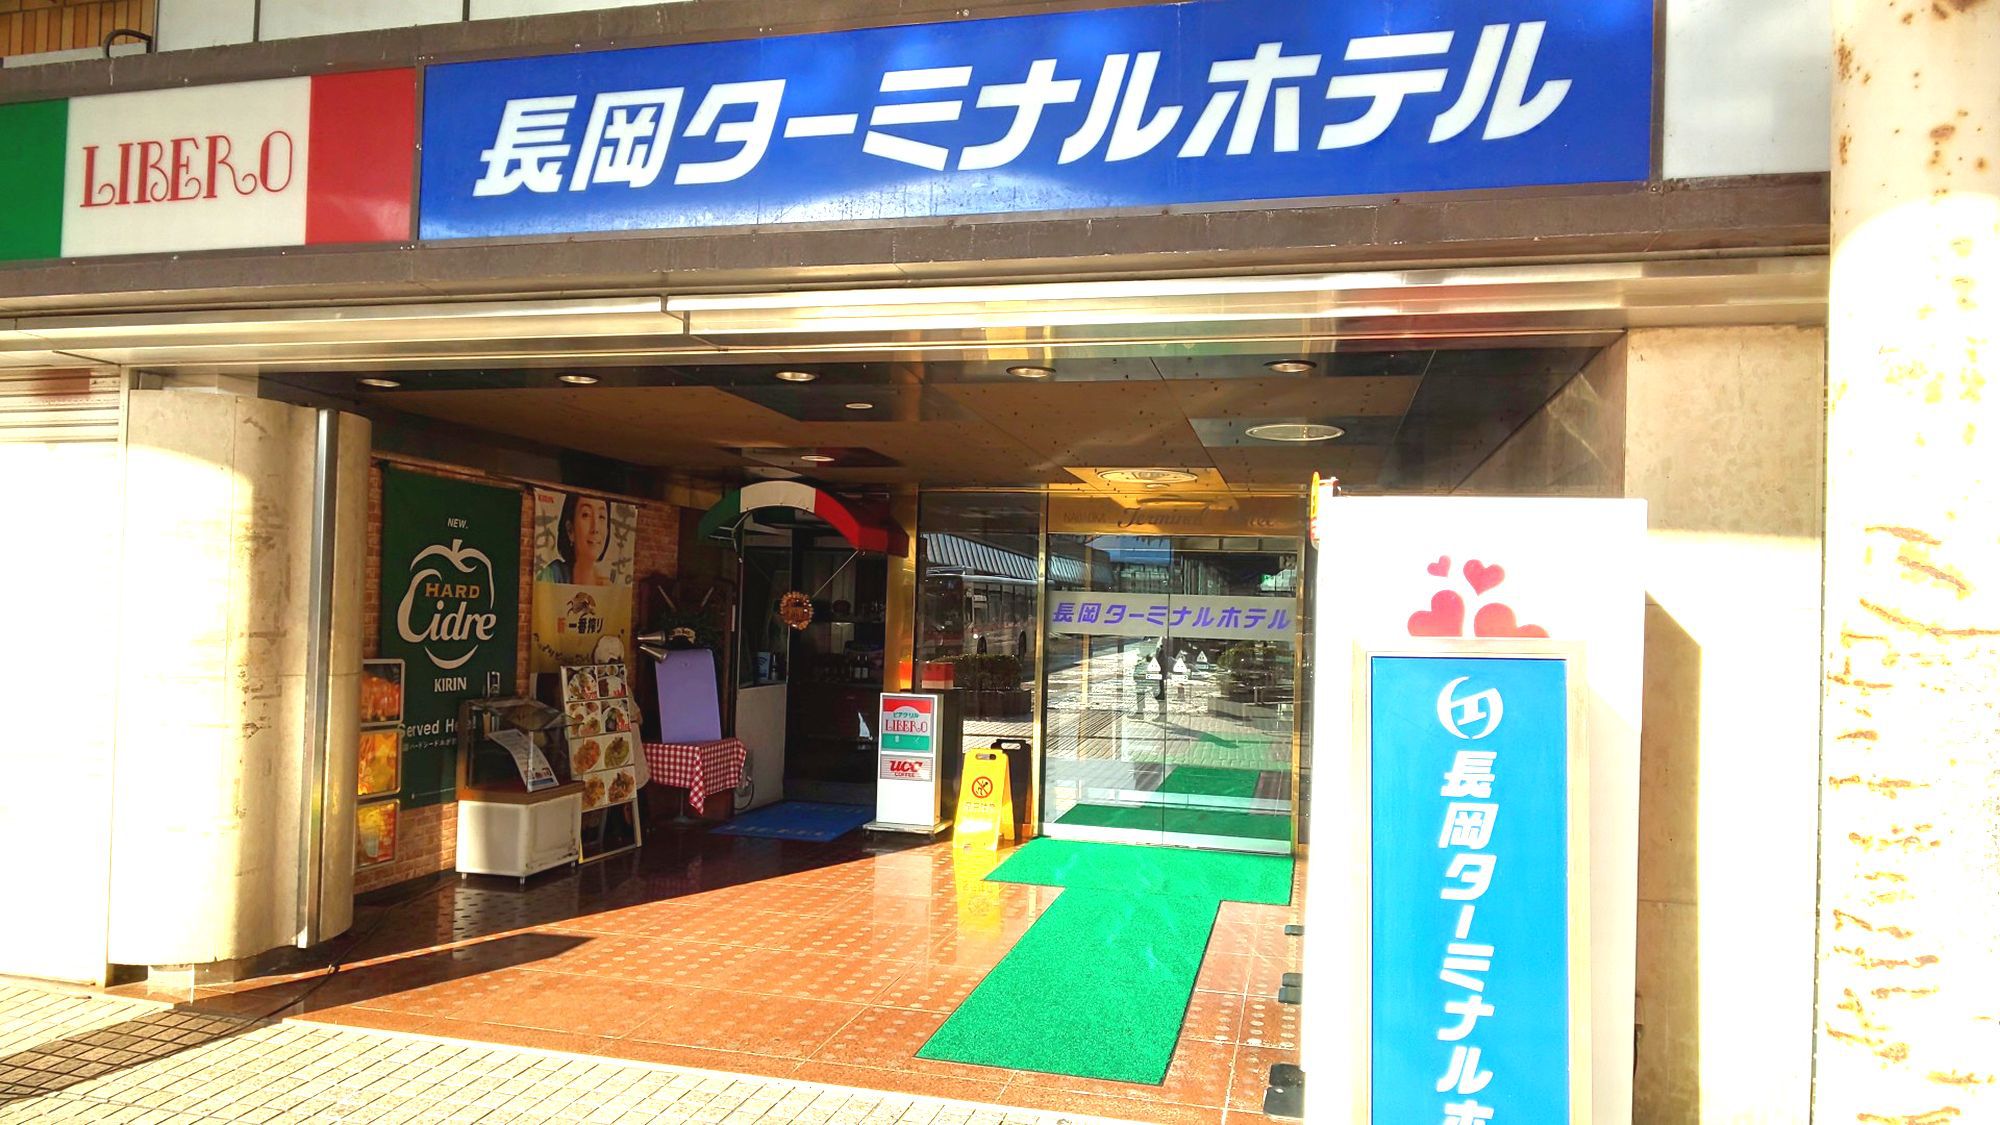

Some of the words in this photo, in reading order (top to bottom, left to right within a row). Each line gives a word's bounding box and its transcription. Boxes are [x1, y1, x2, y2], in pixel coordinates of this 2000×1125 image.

[473, 21, 1571, 197] 長岡ターミナルホテル
[80, 130, 294, 208] LIBERO
[447, 517, 469, 529] NEW.
[425, 583, 480, 599] HARD
[397, 568, 497, 643] Cidre
[1052, 602, 1292, 630] 長岡ターミナルホテル
[434, 676, 467, 693] KIRIN
[396, 719, 440, 738] Served
[885, 719, 928, 733] LIBERO
[889, 760, 923, 773] UCC
